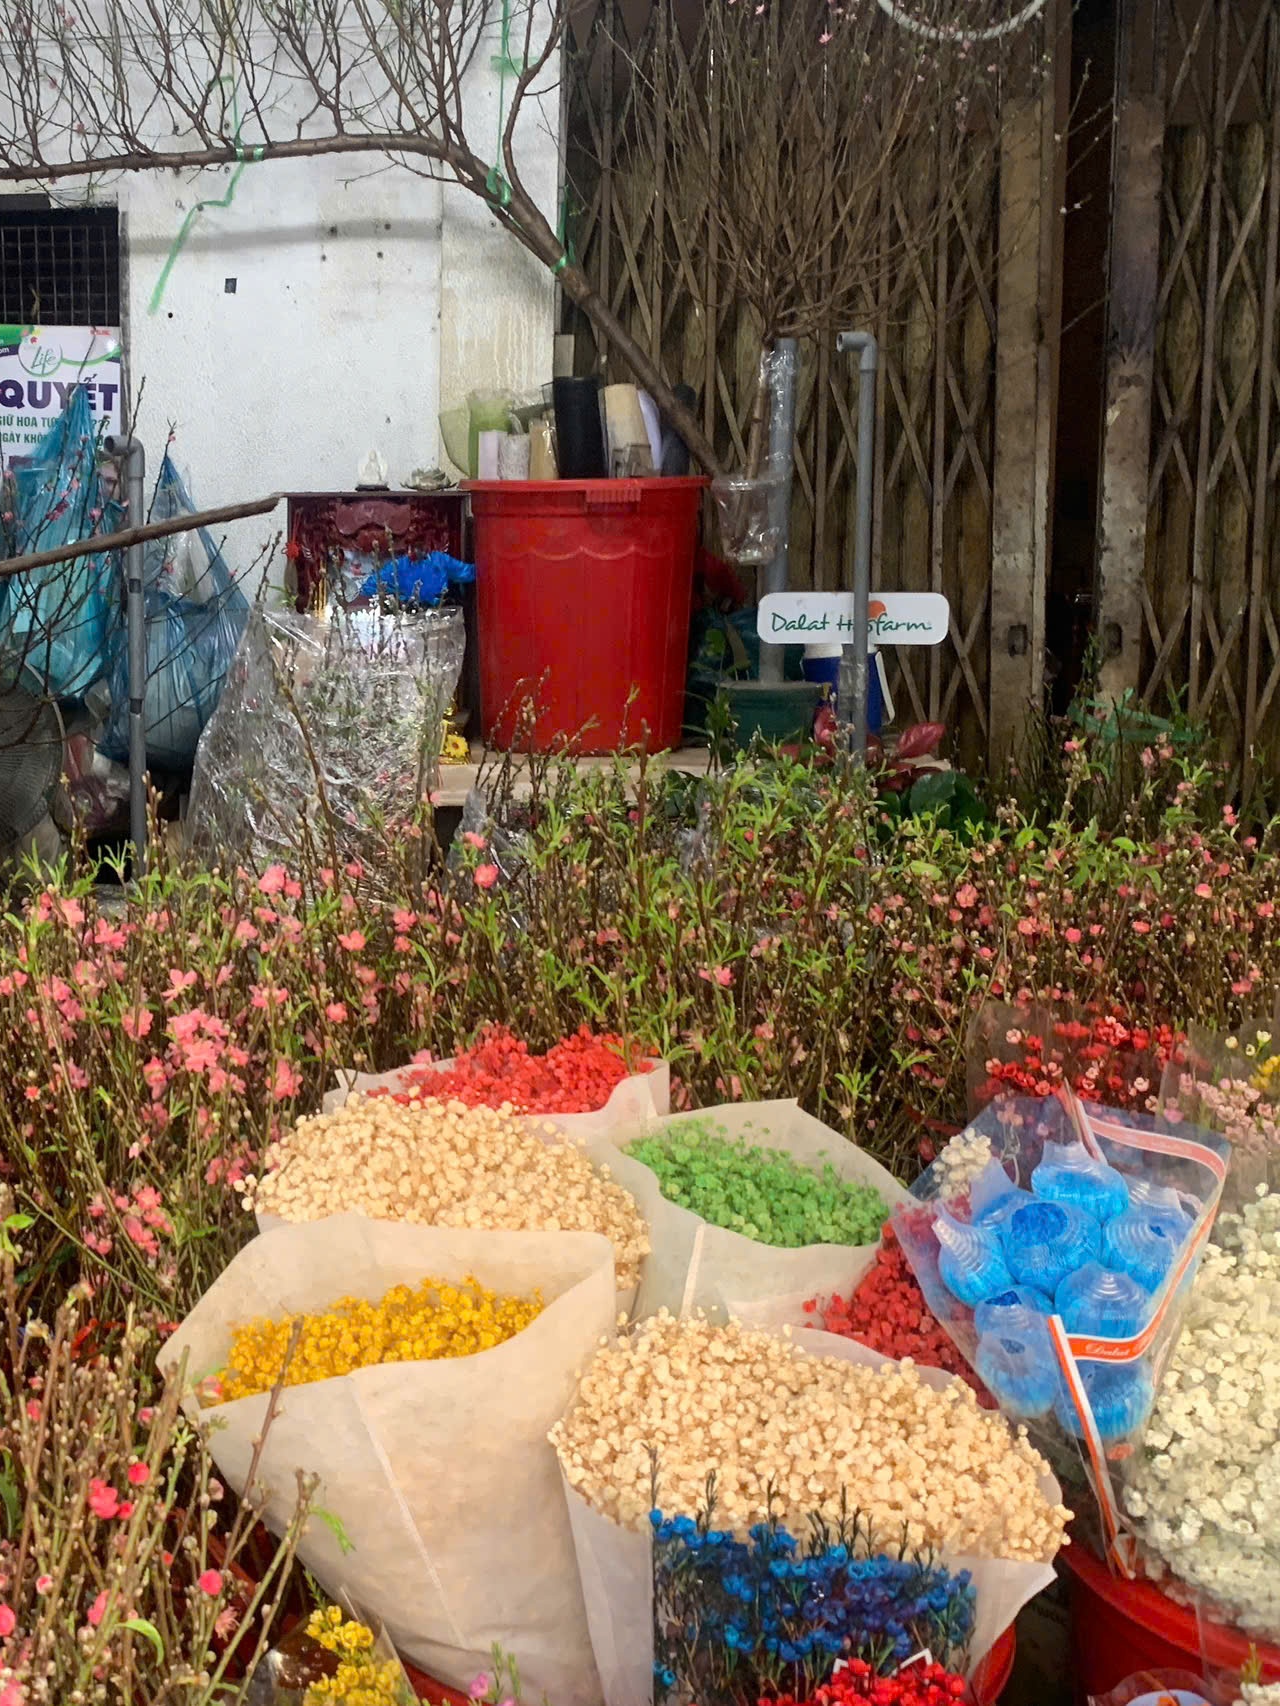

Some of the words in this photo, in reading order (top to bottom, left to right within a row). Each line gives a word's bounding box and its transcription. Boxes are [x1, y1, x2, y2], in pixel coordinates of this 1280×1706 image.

[16, 416, 38, 427] HOA
[771, 612, 830, 632] Dalat
[836, 612, 933, 636] Hsfarm
